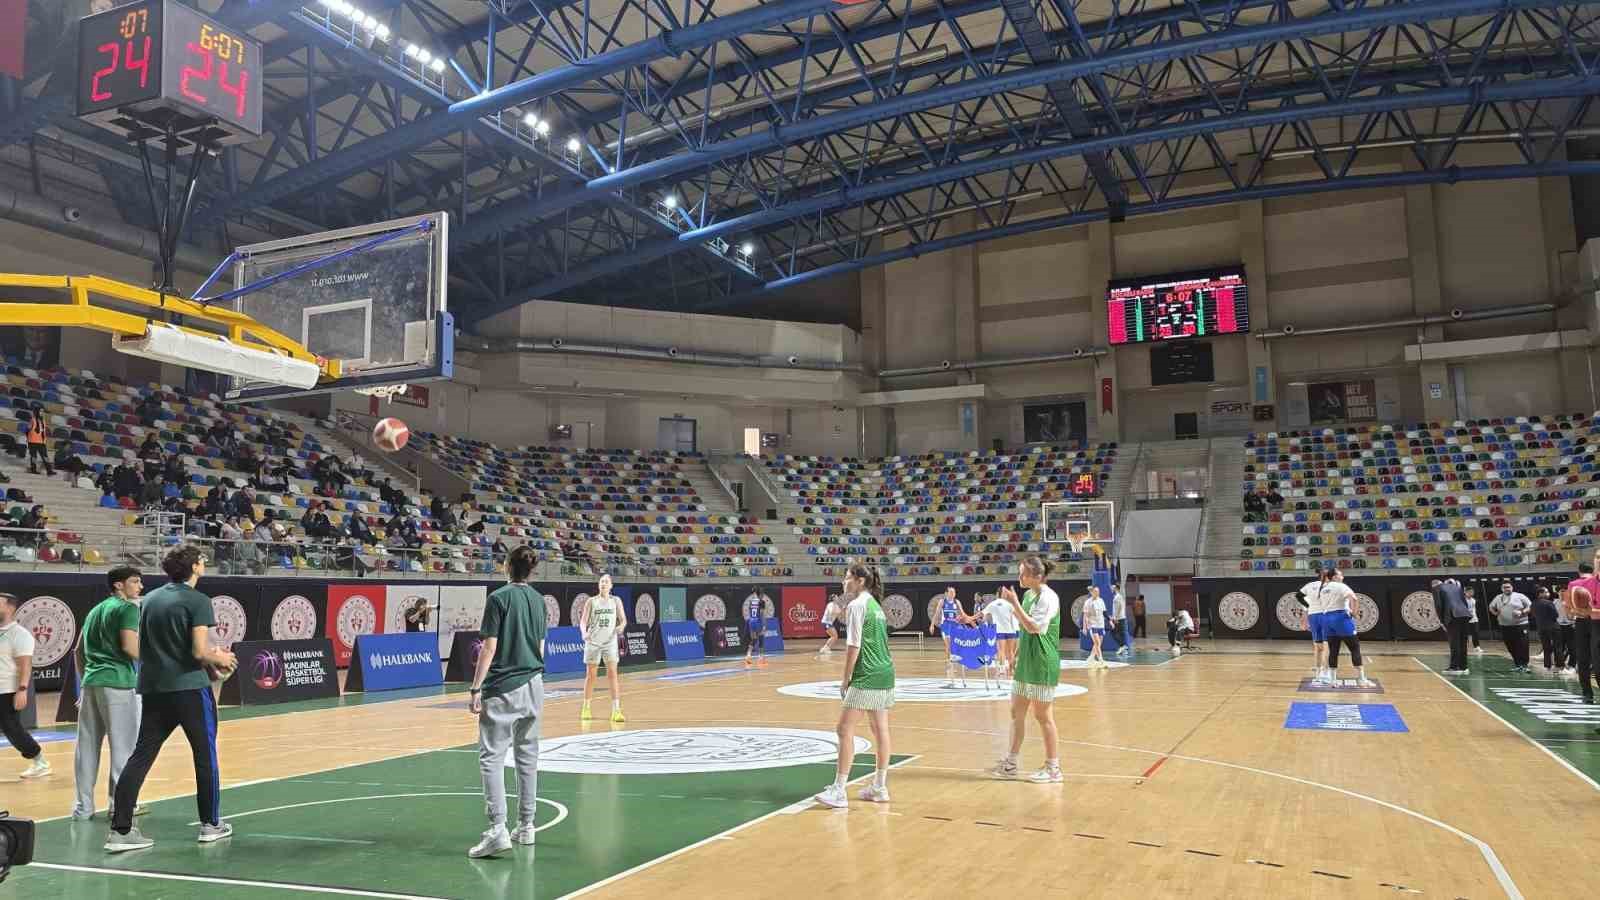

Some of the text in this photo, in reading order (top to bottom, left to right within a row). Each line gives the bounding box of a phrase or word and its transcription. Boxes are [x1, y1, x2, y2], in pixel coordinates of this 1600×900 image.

[200, 24, 244, 64] 6:07
[91, 36, 152, 102] 24
[181, 42, 248, 118] 24
[1166, 291, 1192, 303] 6:07
[1075, 480, 1093, 493] 24
[556, 642, 586, 654] HALKBAN
[290, 650, 325, 660] HALKBANK
[382, 652, 433, 666] HALKBANK
[284, 660, 321, 671] KADINLAR
[285, 668, 327, 678] BASKETBOL
[286, 676, 309, 687] SÜPER
